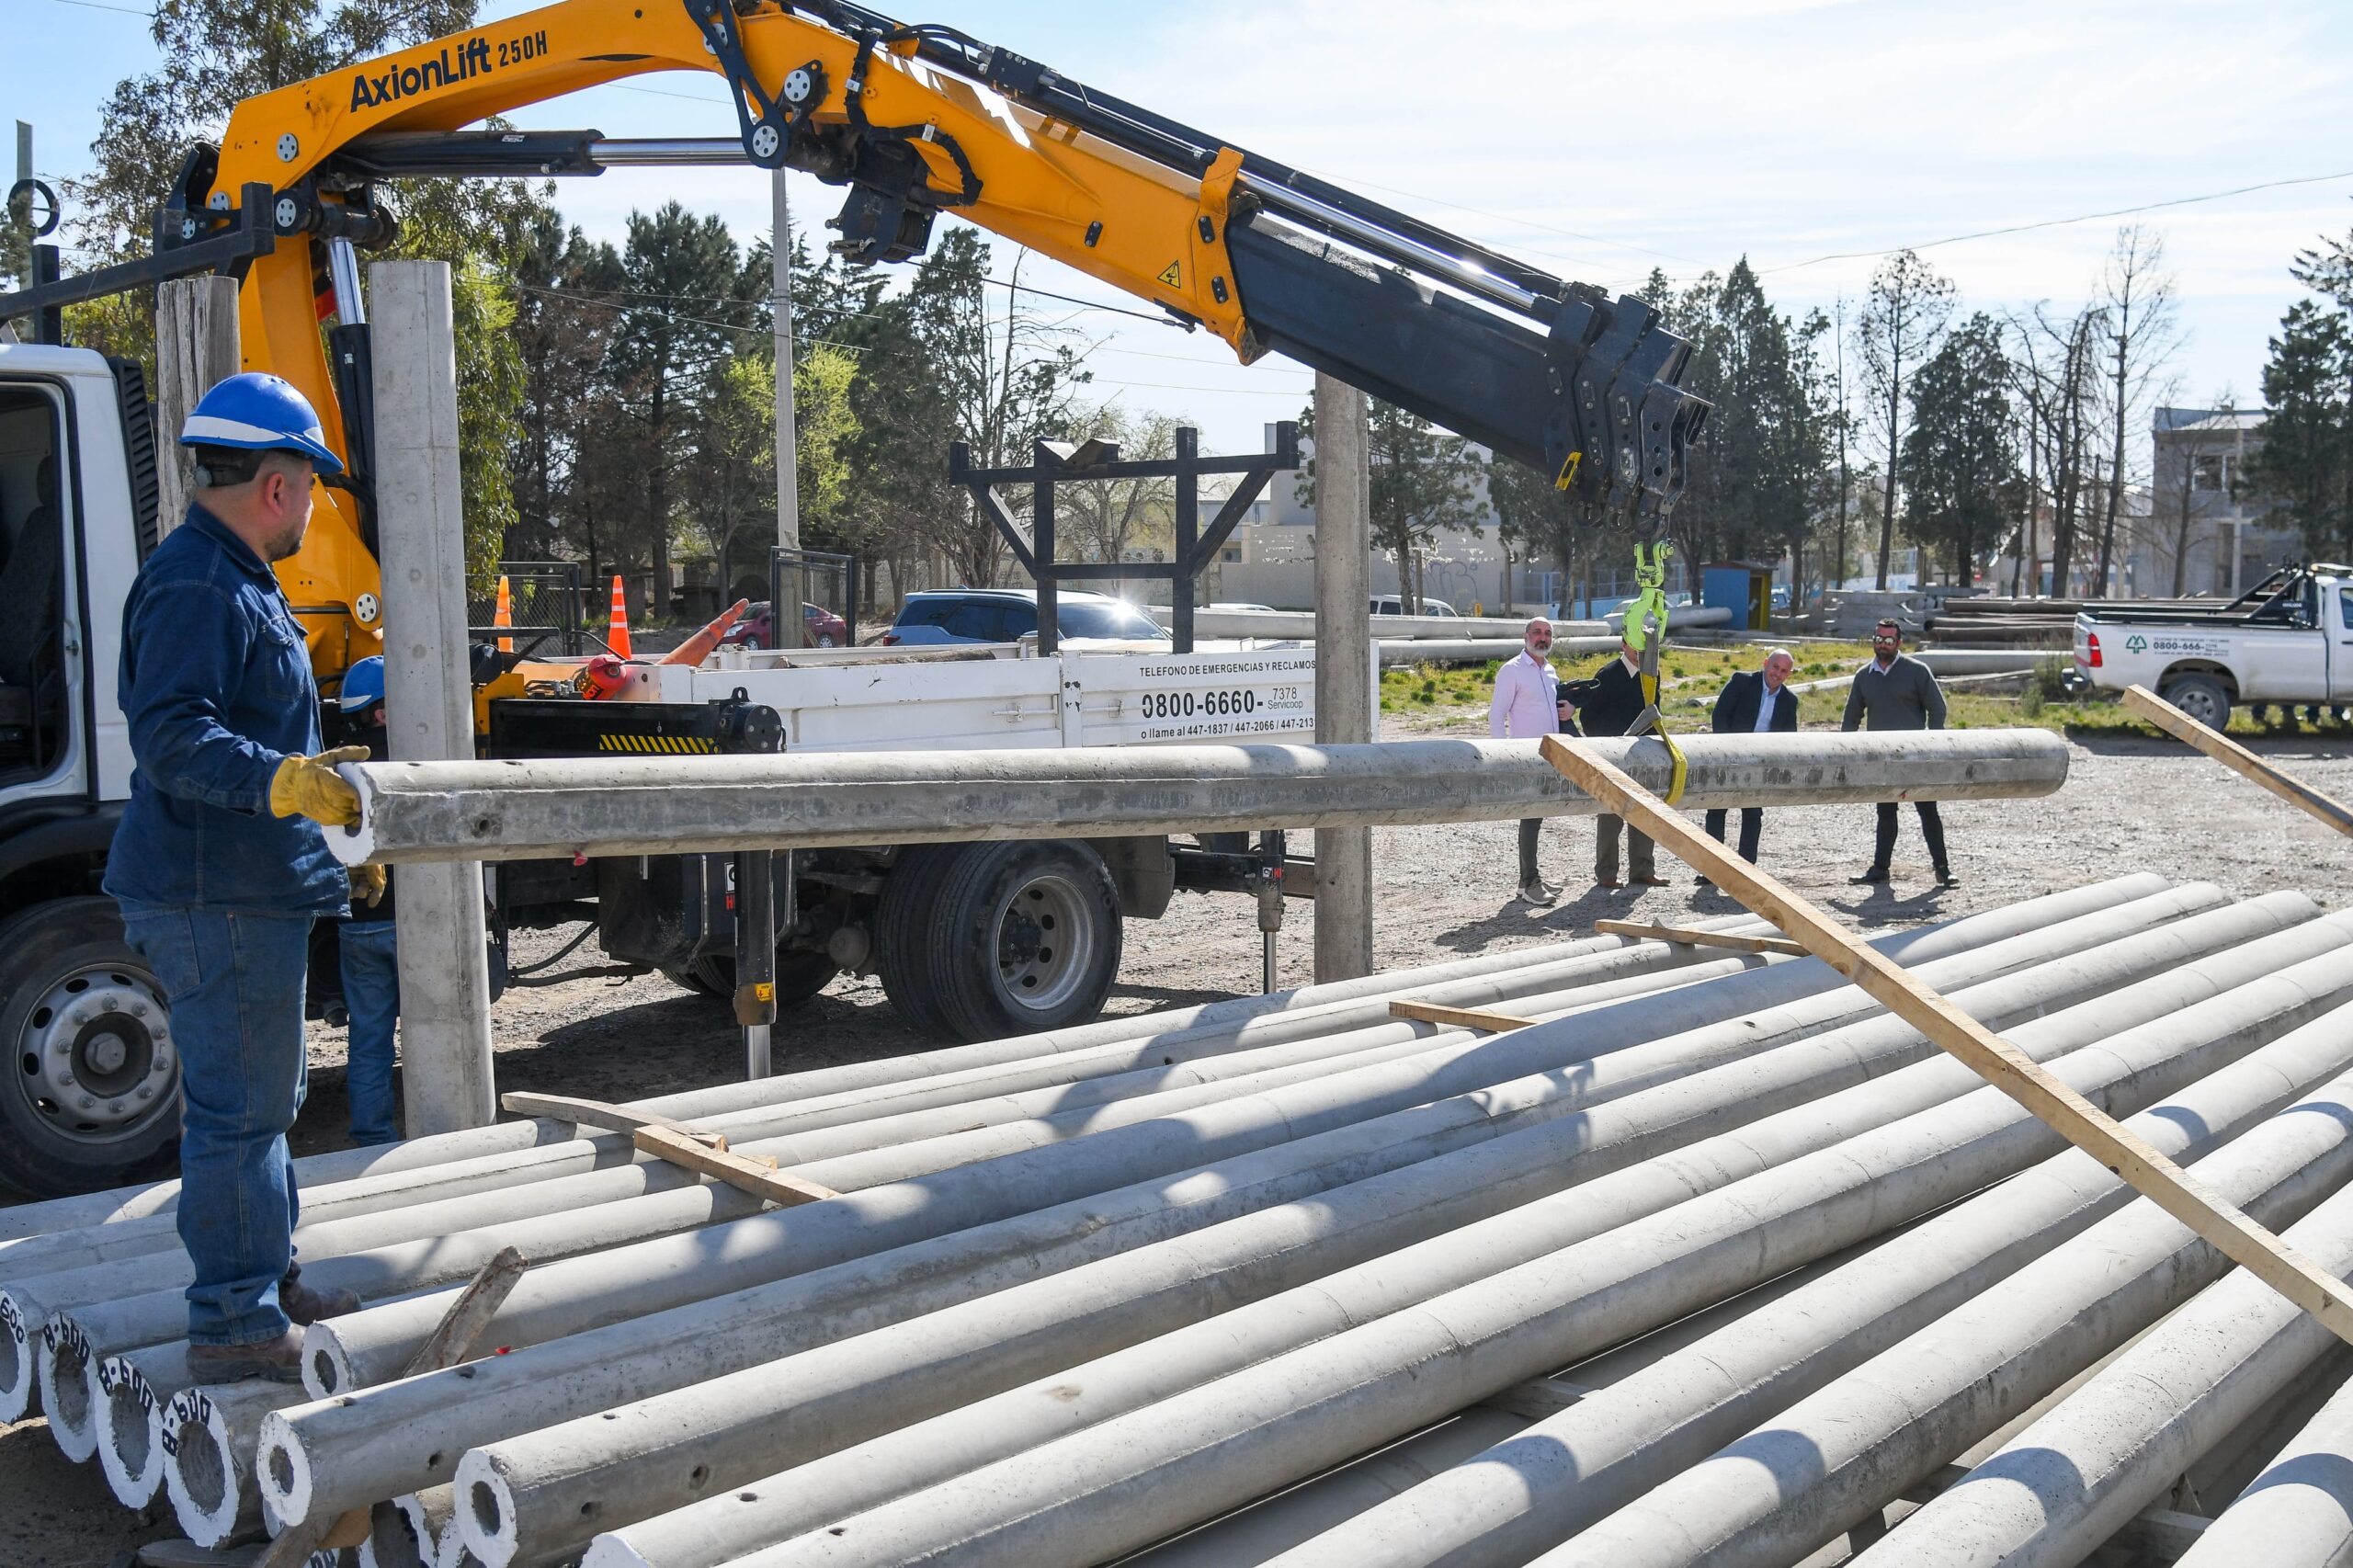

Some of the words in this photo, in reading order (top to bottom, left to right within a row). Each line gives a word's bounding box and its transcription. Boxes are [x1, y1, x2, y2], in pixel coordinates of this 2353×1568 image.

[350, 37, 492, 113] AxionLift
[498, 30, 548, 67] 250H
[1140, 665, 1187, 676] TELEFONO
[1188, 665, 1200, 675] DE
[1202, 662, 1263, 674] EMERGENCIAS
[1265, 662, 1270, 671] Y
[1272, 660, 1315, 671] RECLAMOS
[1267, 699, 1303, 710] Servicoop
[1149, 729, 1175, 739] llame
[1176, 727, 1186, 736] al
[1188, 723, 1228, 736] 447-1837
[1235, 720, 1275, 733] 447-2066
[1280, 717, 1315, 729] 447-213
